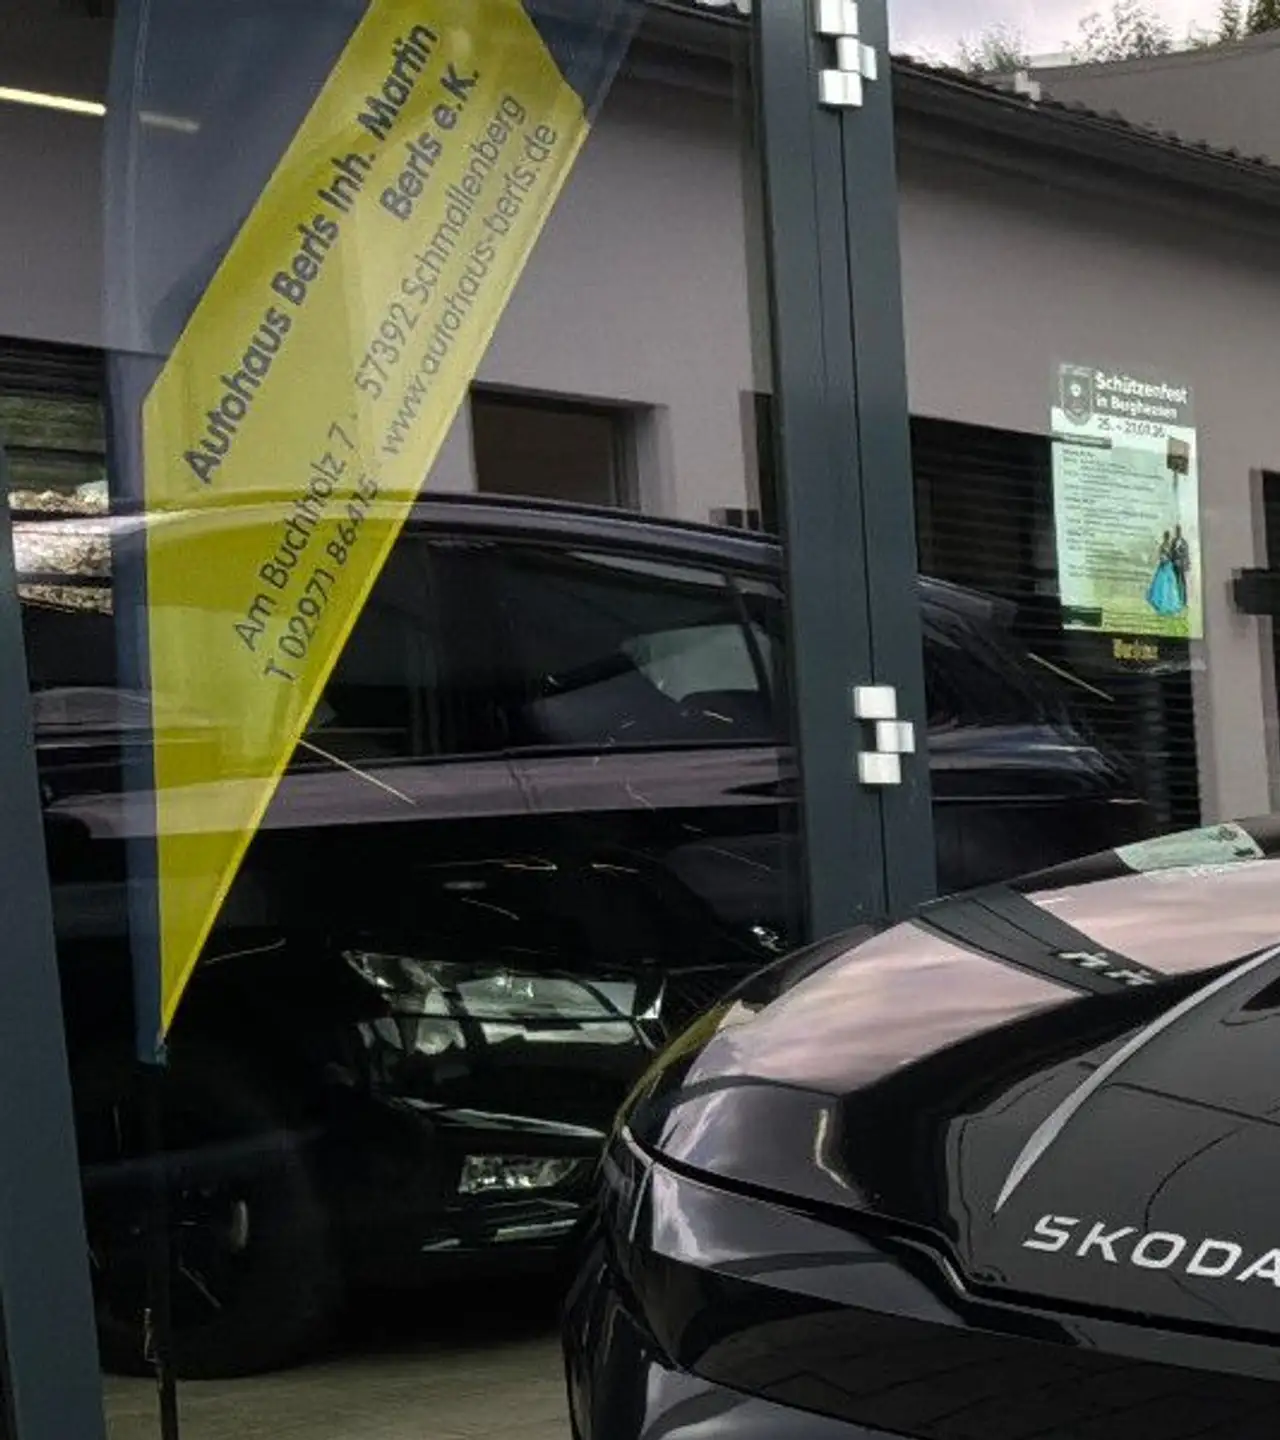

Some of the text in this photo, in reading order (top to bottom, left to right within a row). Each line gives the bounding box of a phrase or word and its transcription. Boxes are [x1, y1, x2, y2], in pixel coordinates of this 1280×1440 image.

[379, 61, 482, 222] Berls e.K.
[183, 23, 439, 485] Autohaus Berls Inh. Martin
[381, 122, 560, 457] www.autohaus-berls.de
[233, 93, 527, 653] Am Buchholz 7 57392 Schmallenberg
[1094, 370, 1189, 404] Schützenfest
[263, 657, 298, 683] T
[277, 567, 338, 660] 02971
